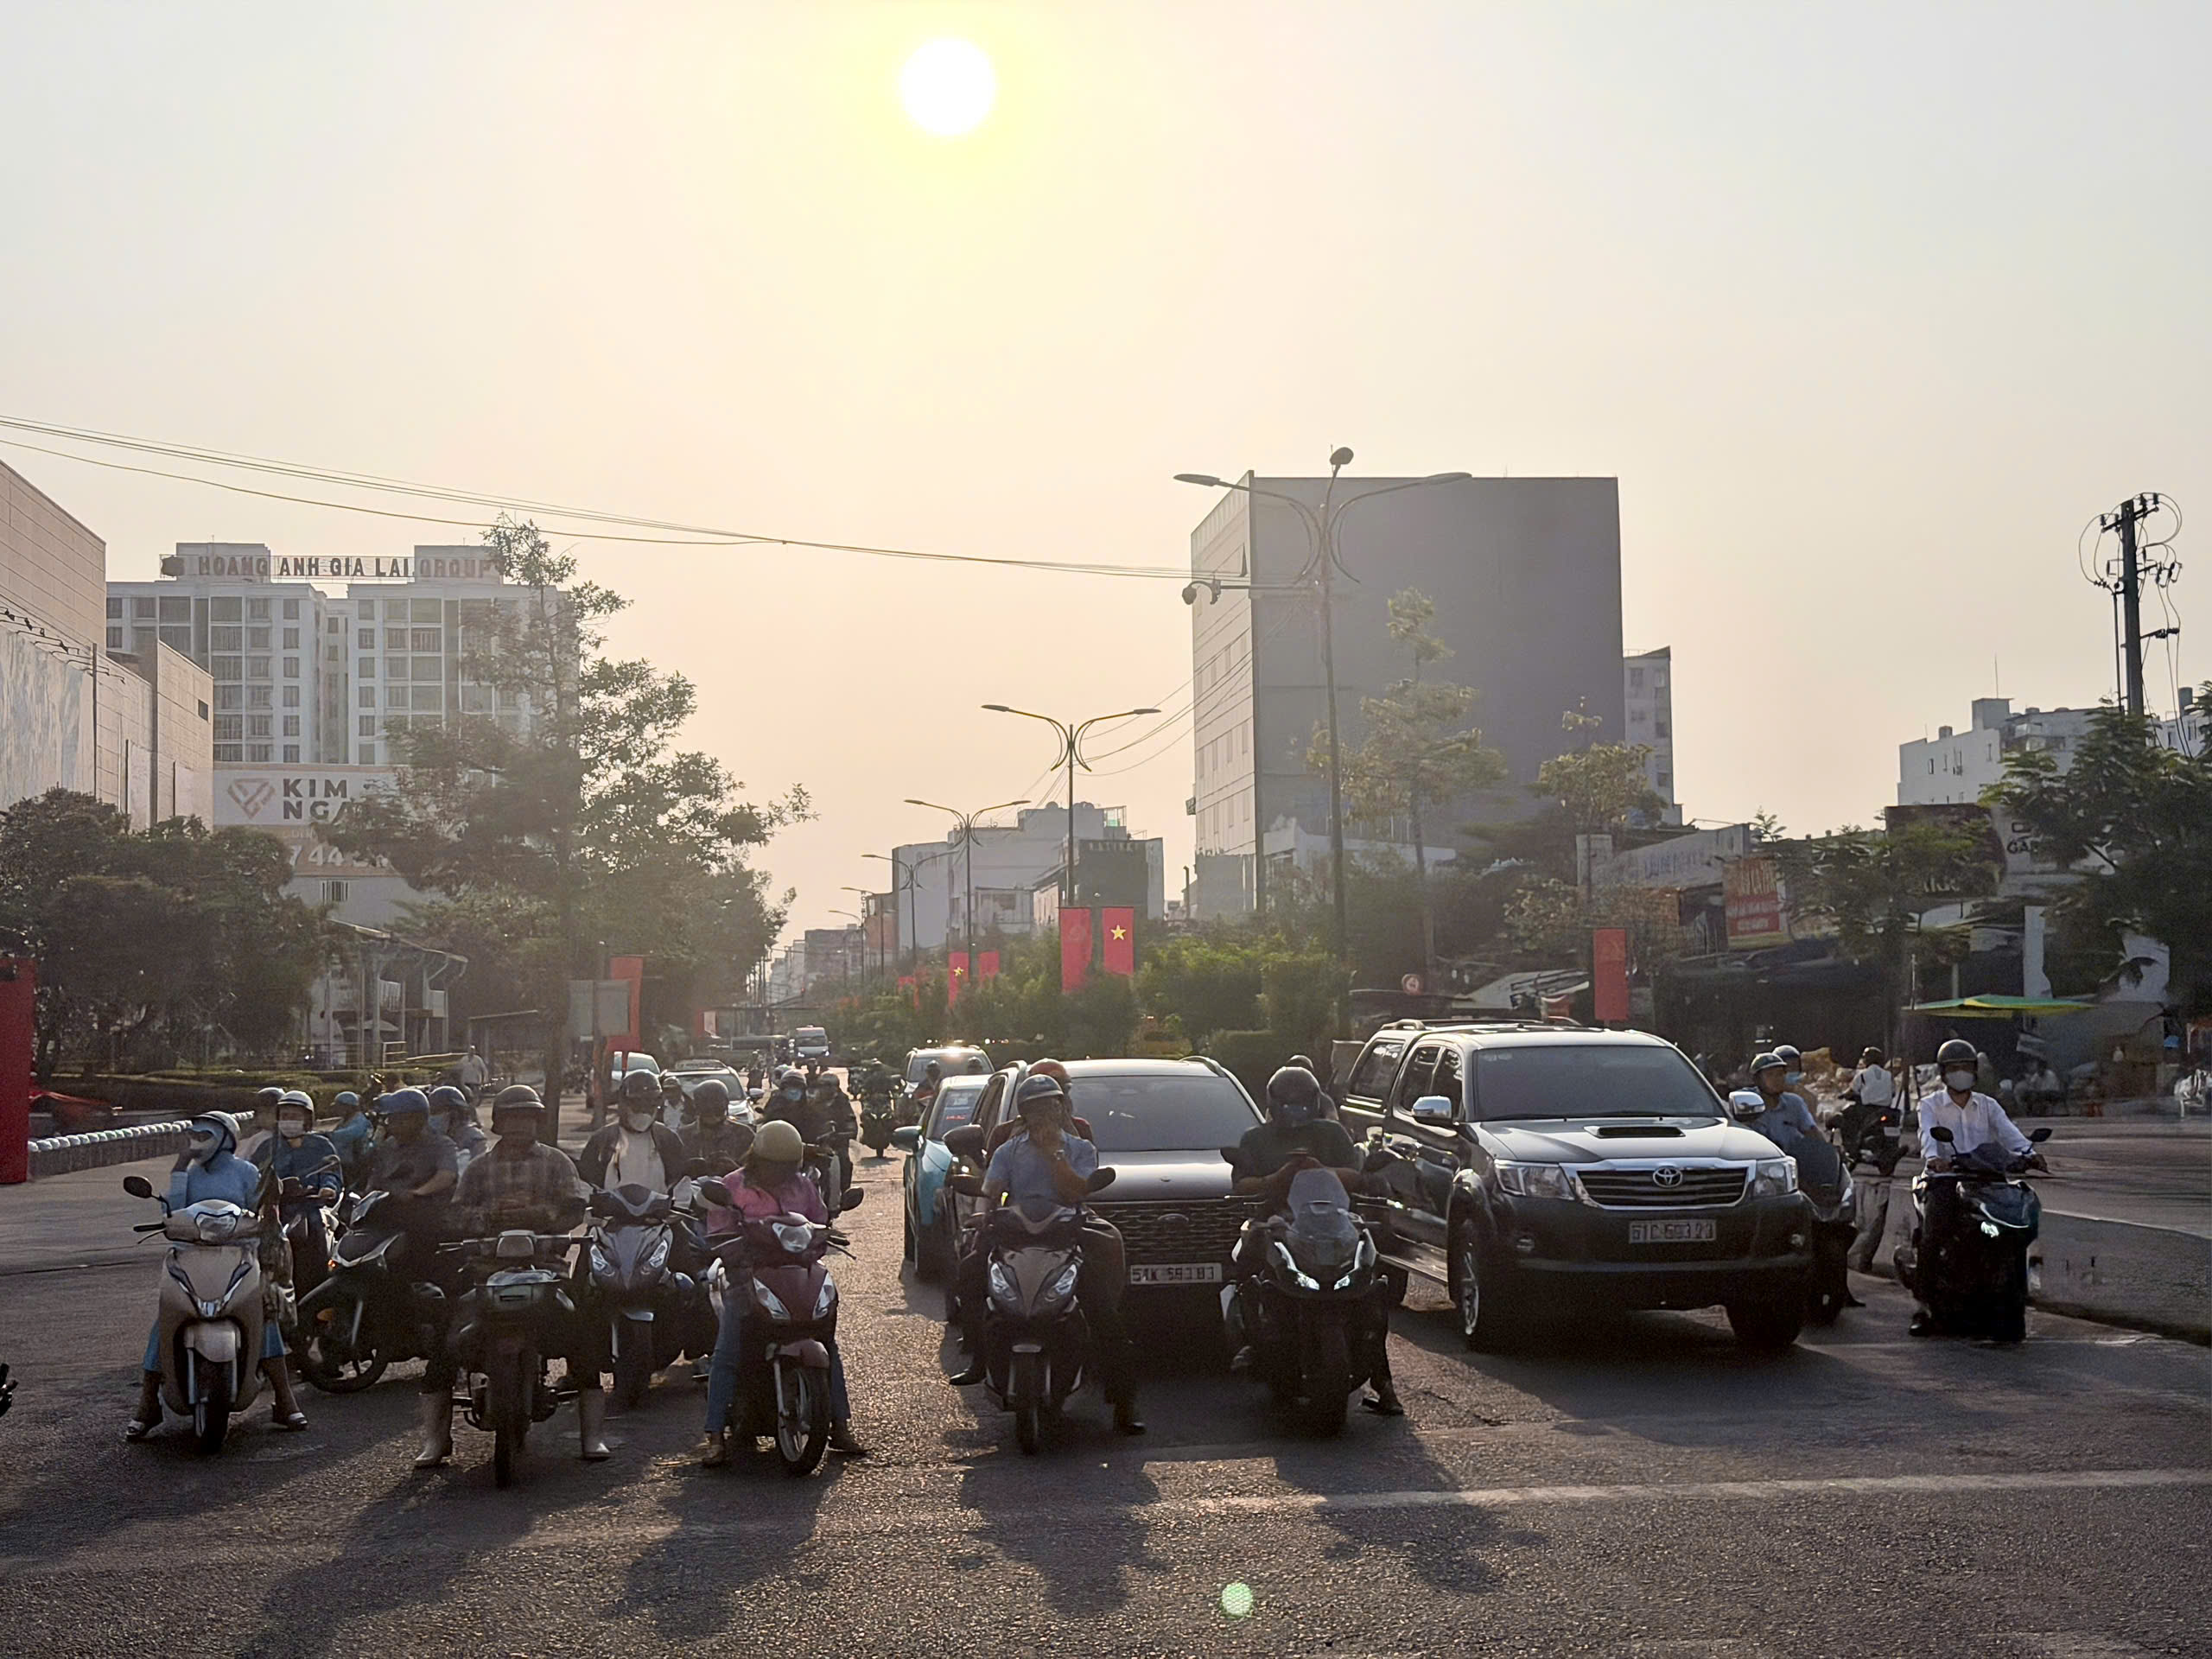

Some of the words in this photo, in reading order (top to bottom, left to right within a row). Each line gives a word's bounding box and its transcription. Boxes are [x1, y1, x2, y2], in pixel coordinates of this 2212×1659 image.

[279, 556, 320, 576] ANH
[330, 556, 365, 576] GIA
[376, 556, 409, 577] LAI
[283, 778, 348, 798] KIM
